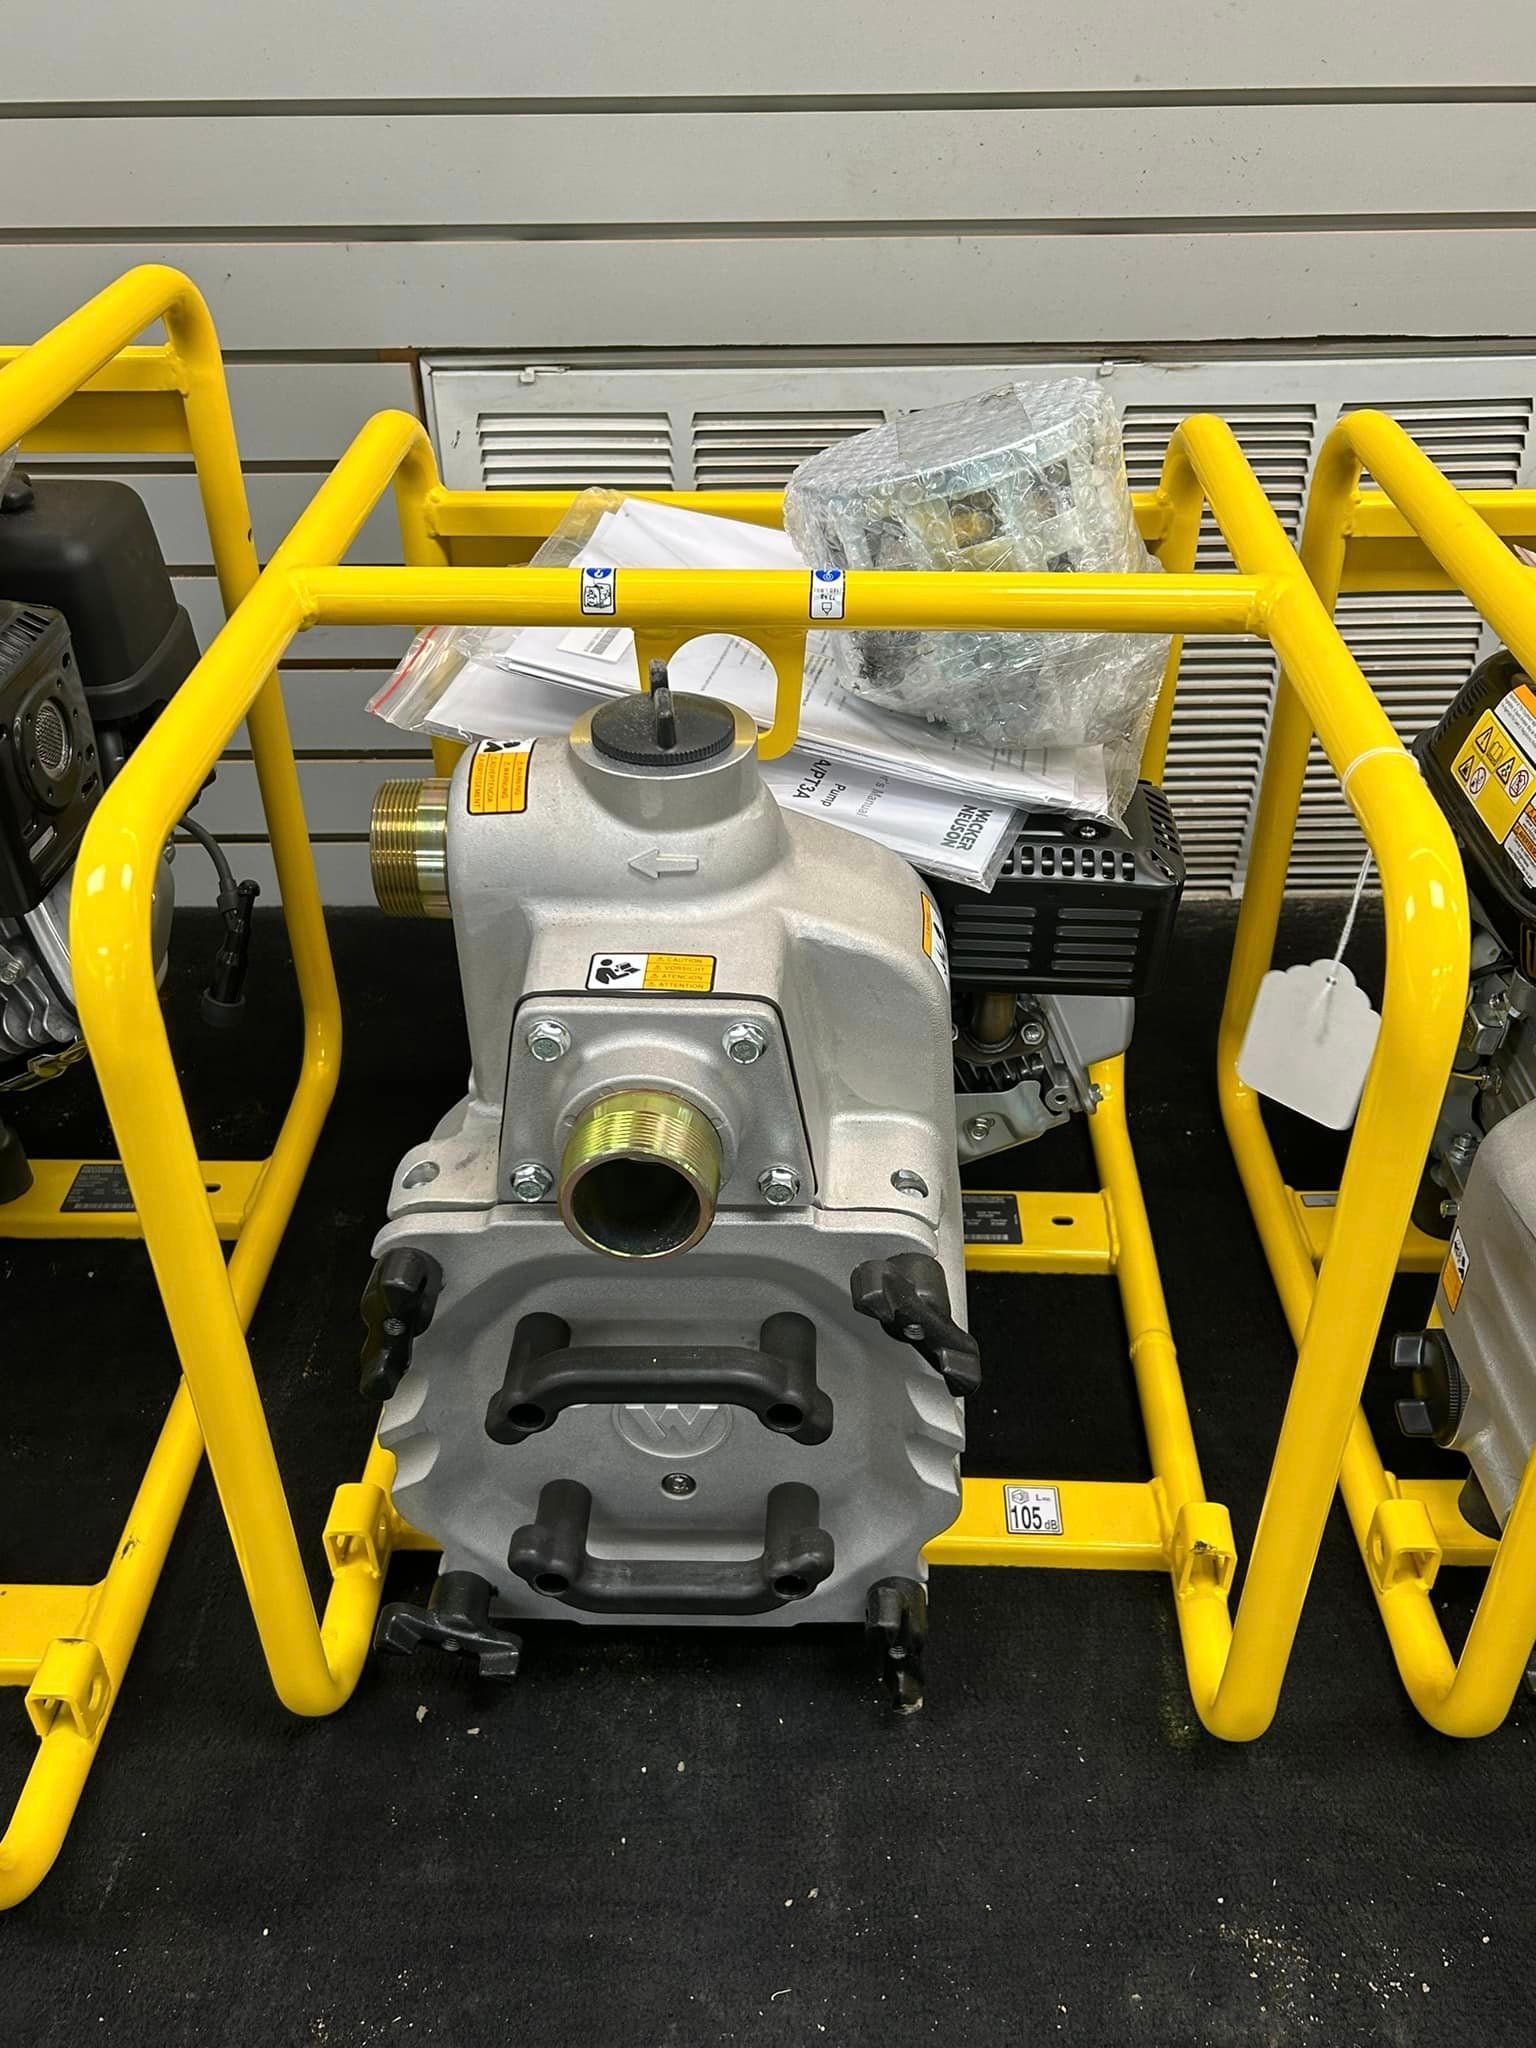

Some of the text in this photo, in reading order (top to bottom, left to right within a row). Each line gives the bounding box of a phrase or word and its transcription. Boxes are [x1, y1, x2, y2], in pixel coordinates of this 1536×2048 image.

[820, 783, 847, 807] Pump
[857, 787, 885, 818] Manual
[940, 804, 978, 848] NEUSON
[956, 809, 993, 850] WACKER
[658, 981, 704, 989] ATTENTION
[1010, 1505, 1058, 1530] 105 dB
